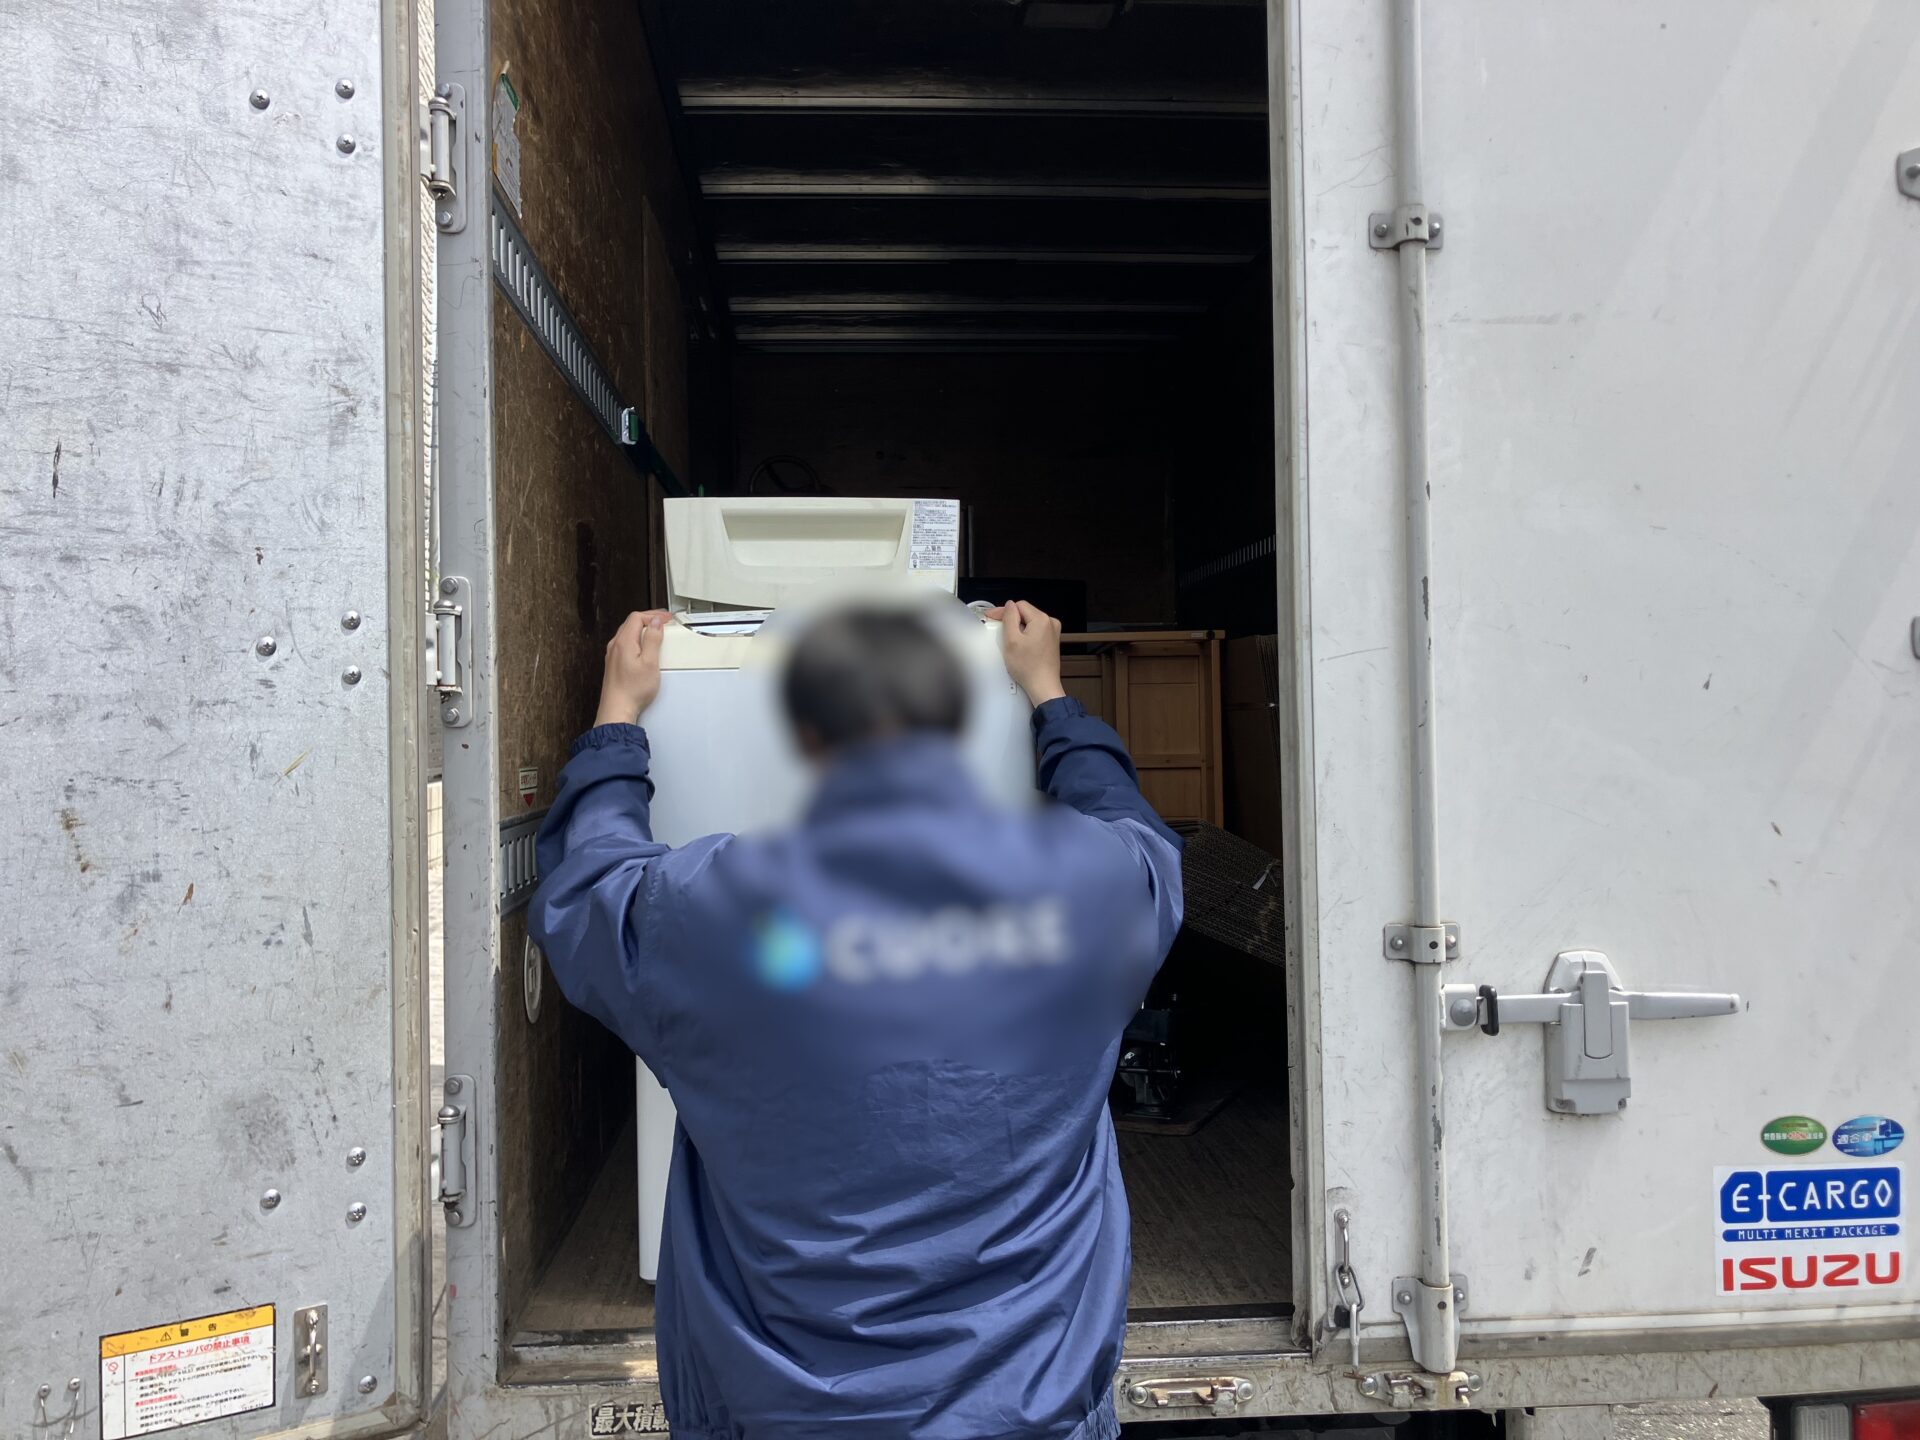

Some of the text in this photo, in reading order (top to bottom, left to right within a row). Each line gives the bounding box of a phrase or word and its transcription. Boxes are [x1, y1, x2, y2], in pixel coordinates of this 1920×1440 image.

[1732, 1179, 1892, 1213] E-CARGO
[1738, 1225, 1887, 1240] MULTI MERIT PACKAGE
[1722, 1251, 1900, 1292] ISUZU
